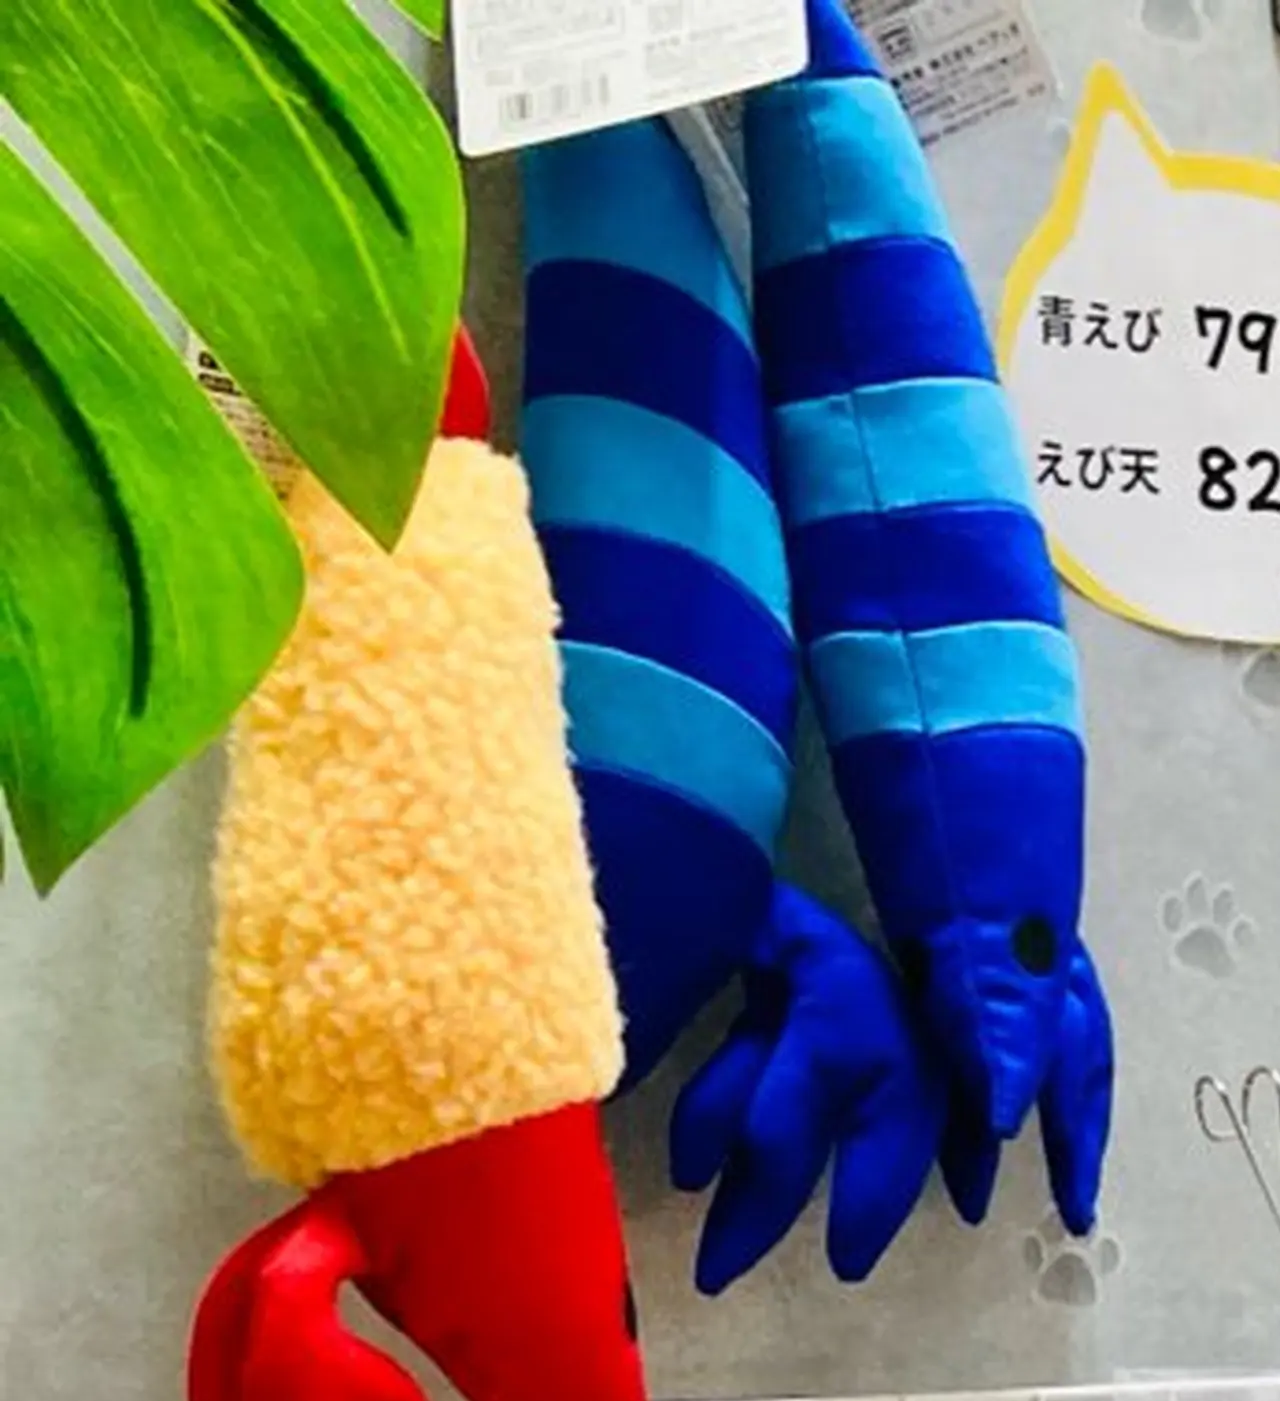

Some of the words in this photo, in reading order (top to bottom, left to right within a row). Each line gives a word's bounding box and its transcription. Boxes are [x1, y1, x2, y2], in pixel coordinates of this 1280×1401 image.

[1037, 296, 1163, 352] 青えび
[1036, 440, 1161, 494] えび天
